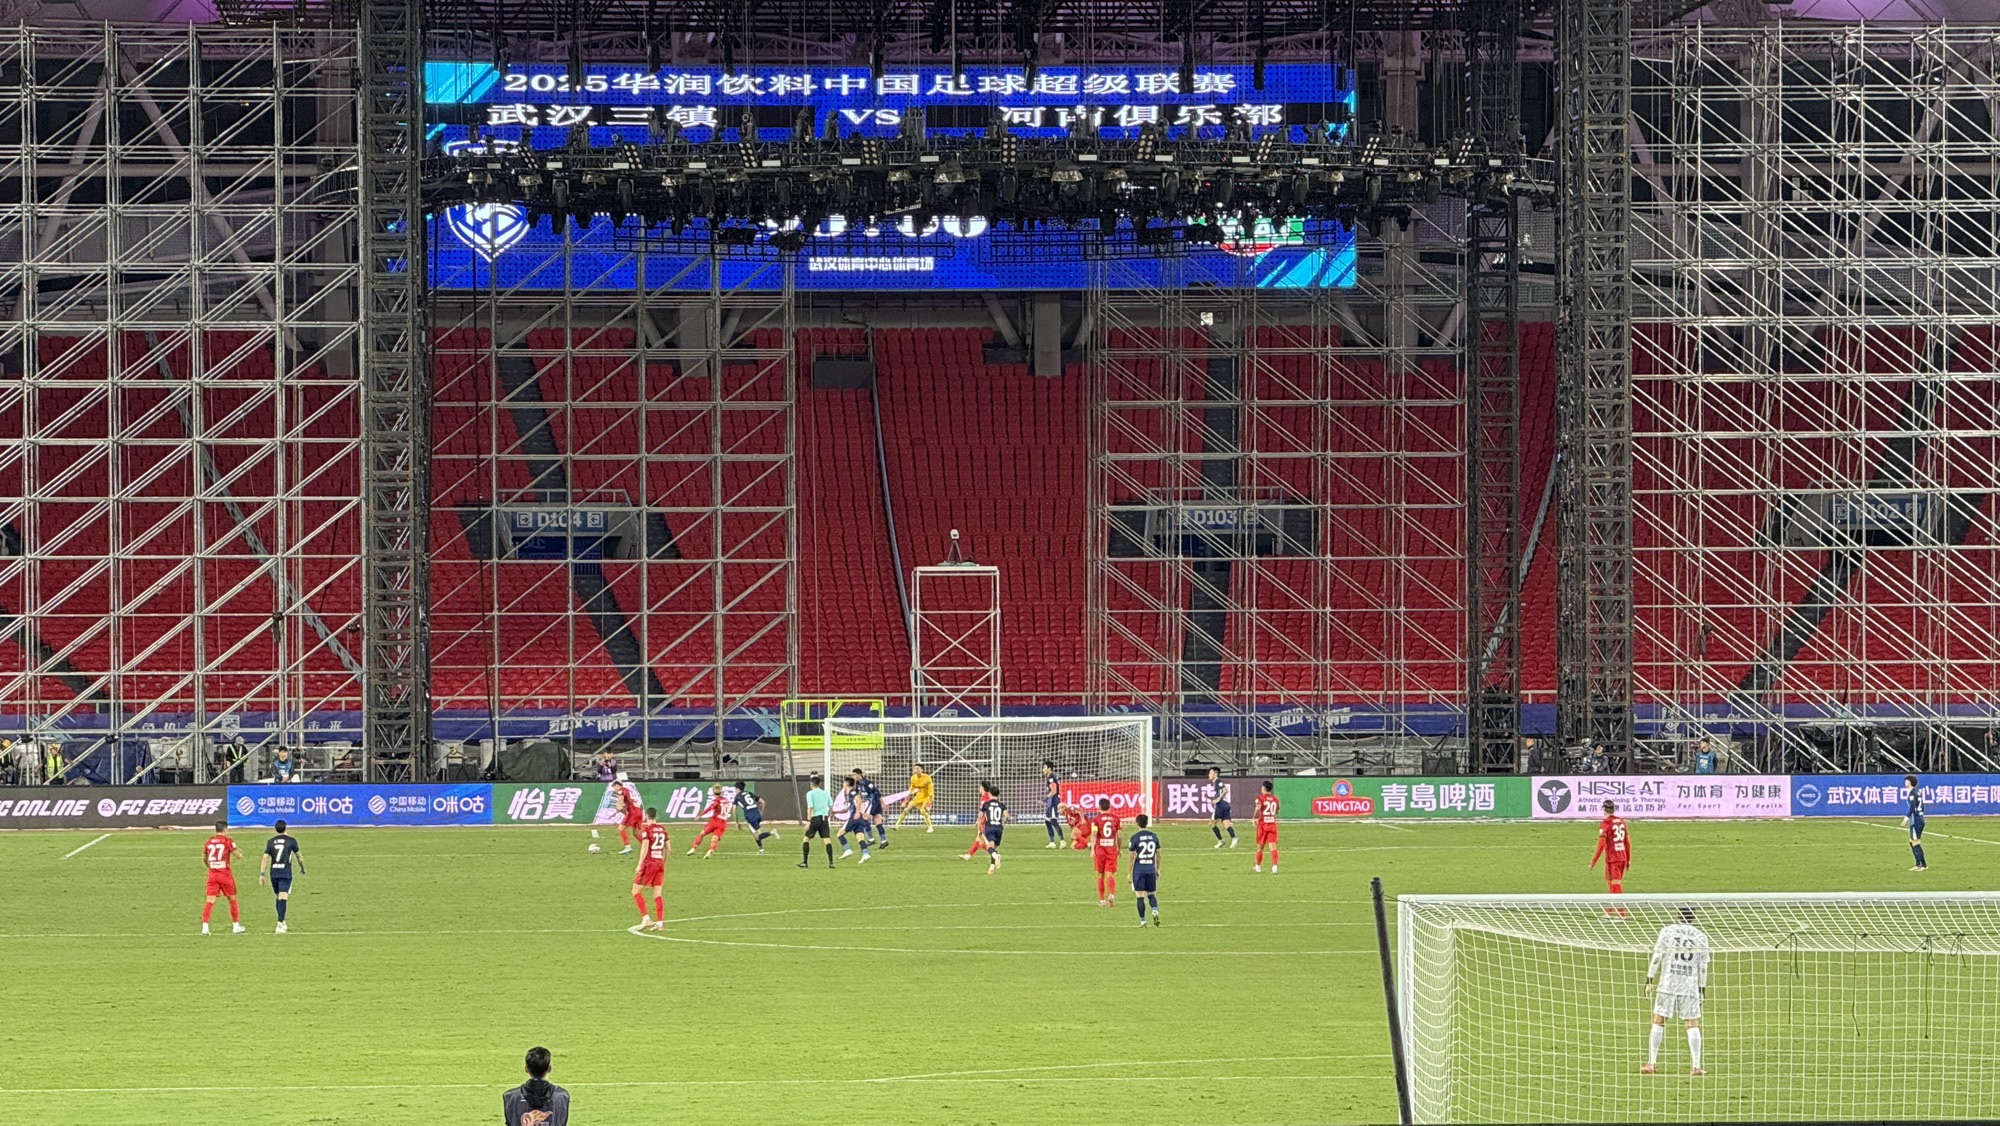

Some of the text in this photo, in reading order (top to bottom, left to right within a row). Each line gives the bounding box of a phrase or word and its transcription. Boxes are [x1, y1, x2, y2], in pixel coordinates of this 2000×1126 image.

[486, 104, 718, 128] 武汉三镇
[838, 109, 900, 126] VS
[537, 511, 583, 528] D104
[1194, 510, 1237, 525] D103
[744, 794, 754, 805] 6
[1677, 784, 1782, 799] 为体育 为健康
[12, 800, 90, 816] ONLINE
[116, 799, 223, 815] FC 足球世界
[257, 797, 295, 807] 中国移动
[302, 796, 353, 814] 咪咕
[389, 796, 426, 806] 中国移动
[433, 795, 484, 813] 咪咕
[507, 787, 582, 819] 怡寶
[1263, 801, 1277, 816] 20
[1315, 800, 1371, 812] TSINGTAO
[1578, 804, 1666, 813] 赫尔康运动防护
[988, 806, 1002, 821] 10
[1102, 821, 1112, 838] 6
[1612, 824, 1625, 841] 36
[651, 832, 665, 850] 23
[207, 843, 225, 862] 27
[274, 844, 285, 863] 7
[1138, 841, 1156, 859] 29
